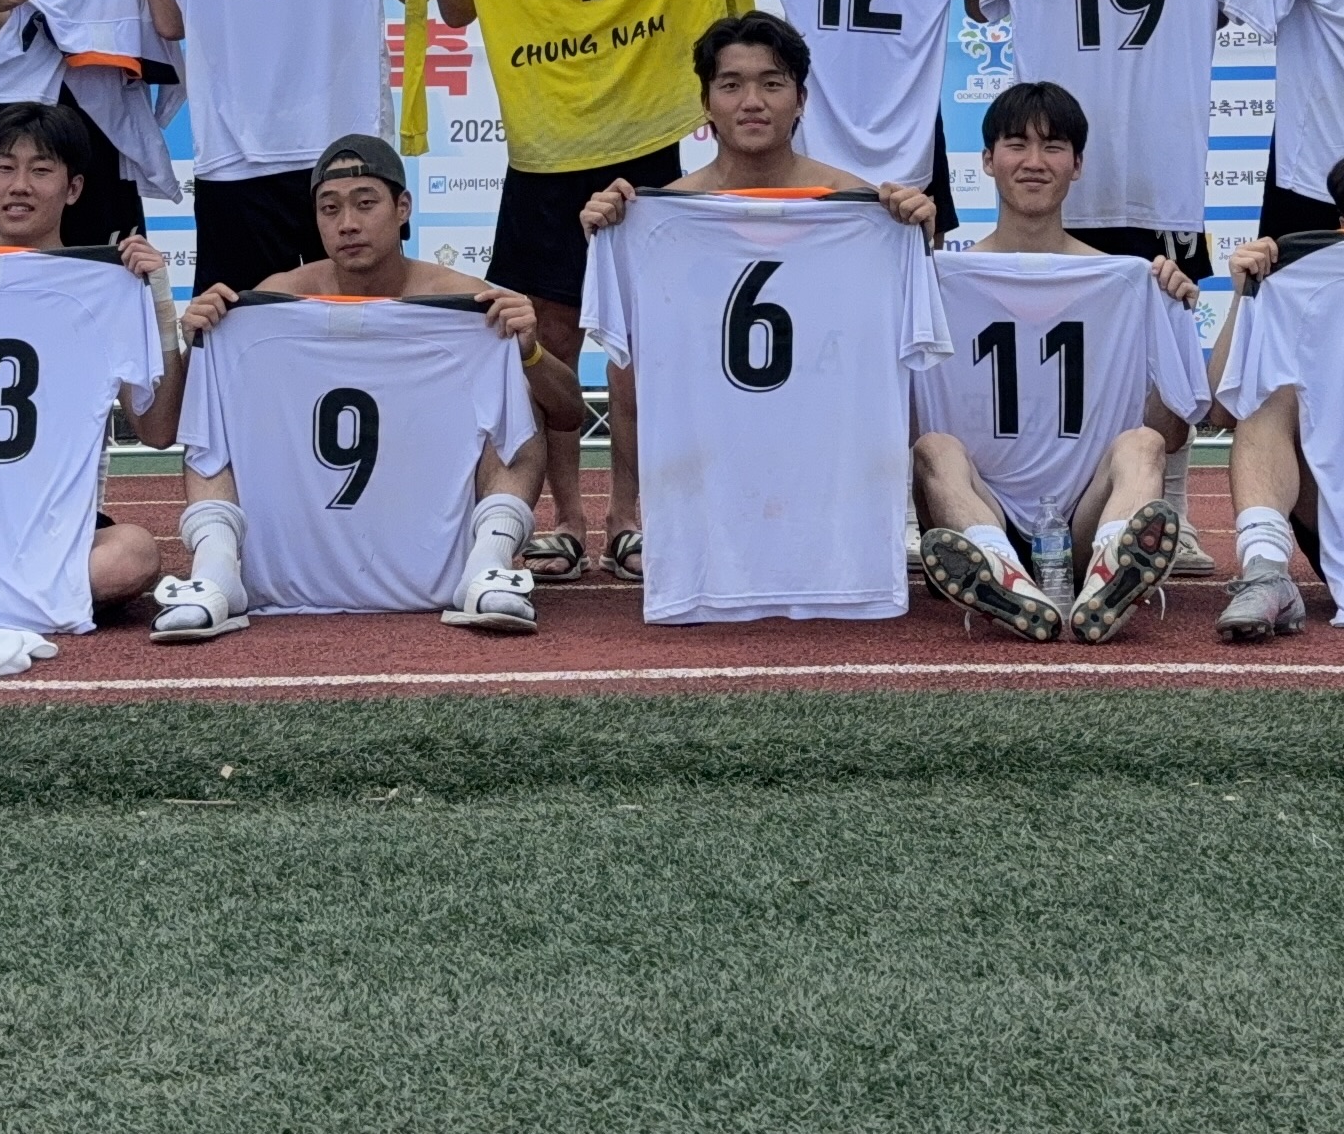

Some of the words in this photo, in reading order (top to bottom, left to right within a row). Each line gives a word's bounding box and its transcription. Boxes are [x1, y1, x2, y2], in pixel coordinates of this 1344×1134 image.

[510, 34, 598, 68] CHUNG
[611, 14, 666, 50] NAM
[450, 120, 507, 143] 2025
[1205, 170, 1266, 186] 성군체육
[721, 260, 794, 393] 6
[972, 321, 1085, 440] 11
[312, 387, 380, 511] 9
